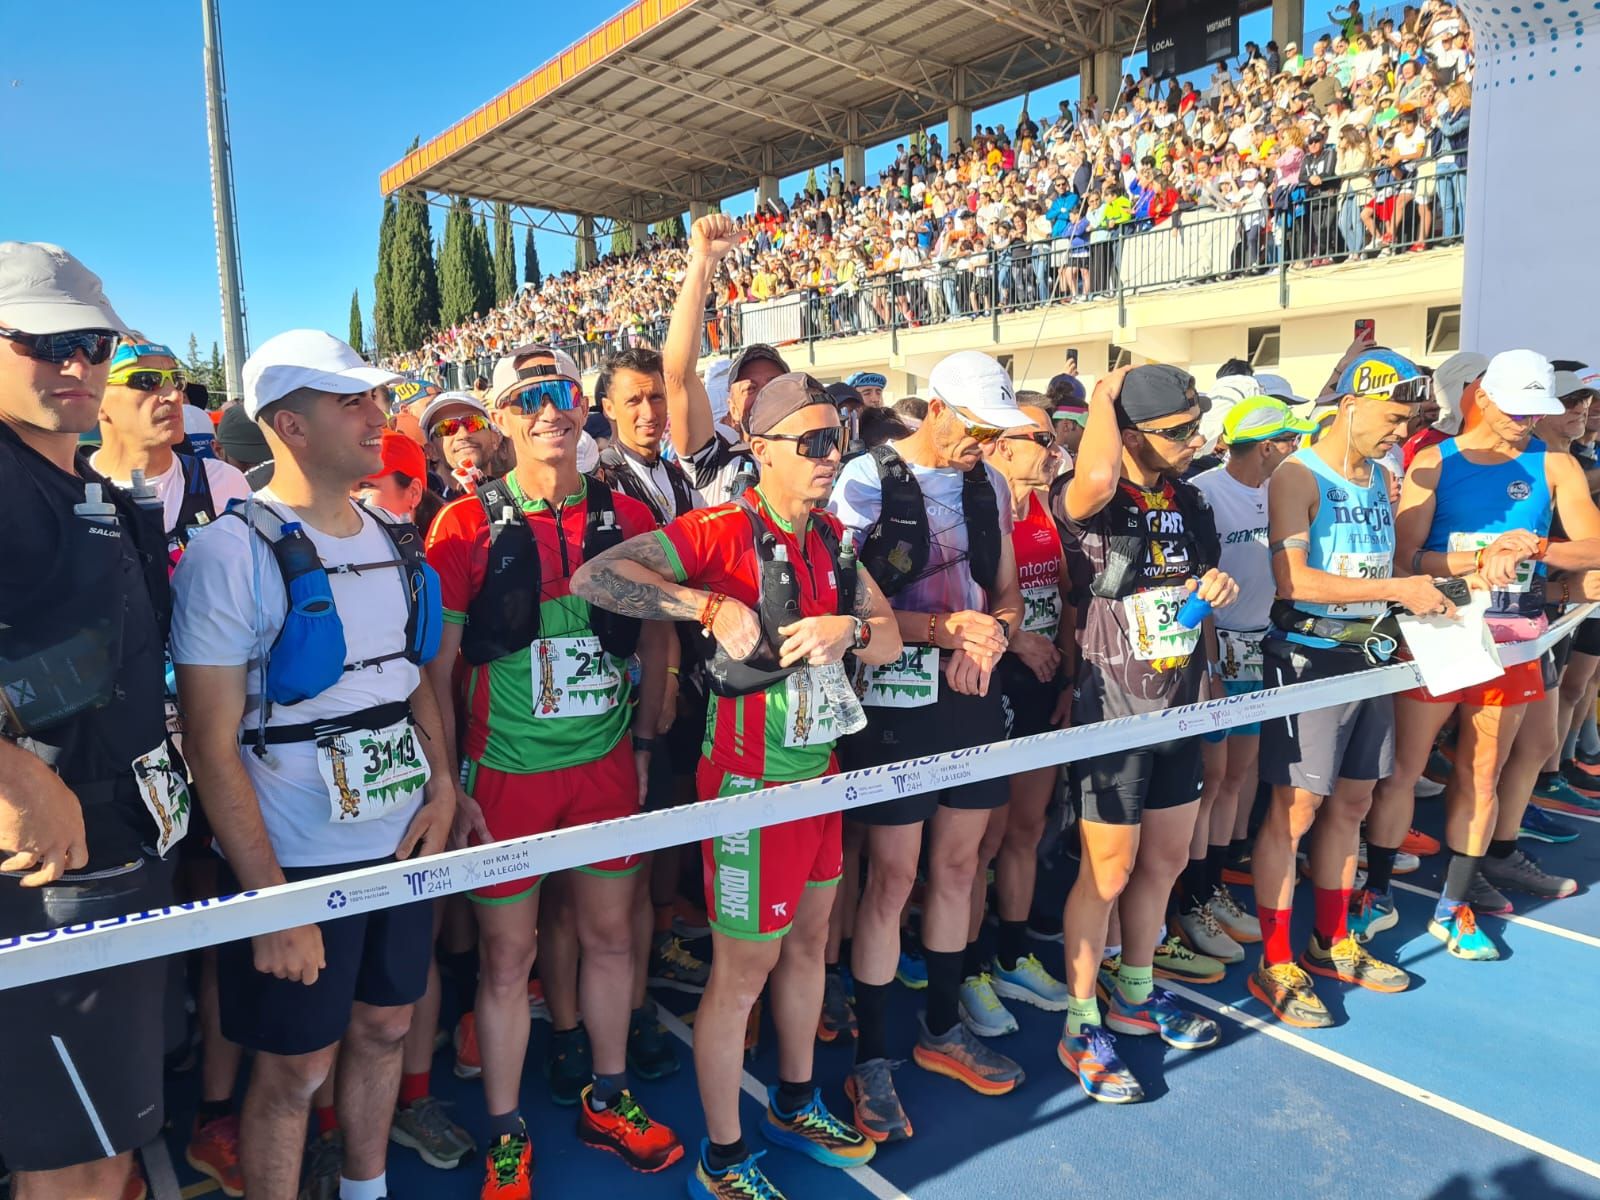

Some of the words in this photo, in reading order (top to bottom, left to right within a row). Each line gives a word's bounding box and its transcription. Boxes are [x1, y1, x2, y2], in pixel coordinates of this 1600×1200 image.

[1206, 17, 1231, 33] VISITANTE
[1151, 38, 1174, 53] LOCAL
[1332, 501, 1391, 532] nerja
[1030, 597, 1057, 618] 175
[362, 734, 416, 774] 3119
[496, 854, 510, 863] KM
[522, 850, 529, 858] H
[429, 866, 450, 880] KM
[483, 869, 495, 878] LA
[497, 861, 530, 875] LEGIÓN
[427, 879, 452, 893] 24H
